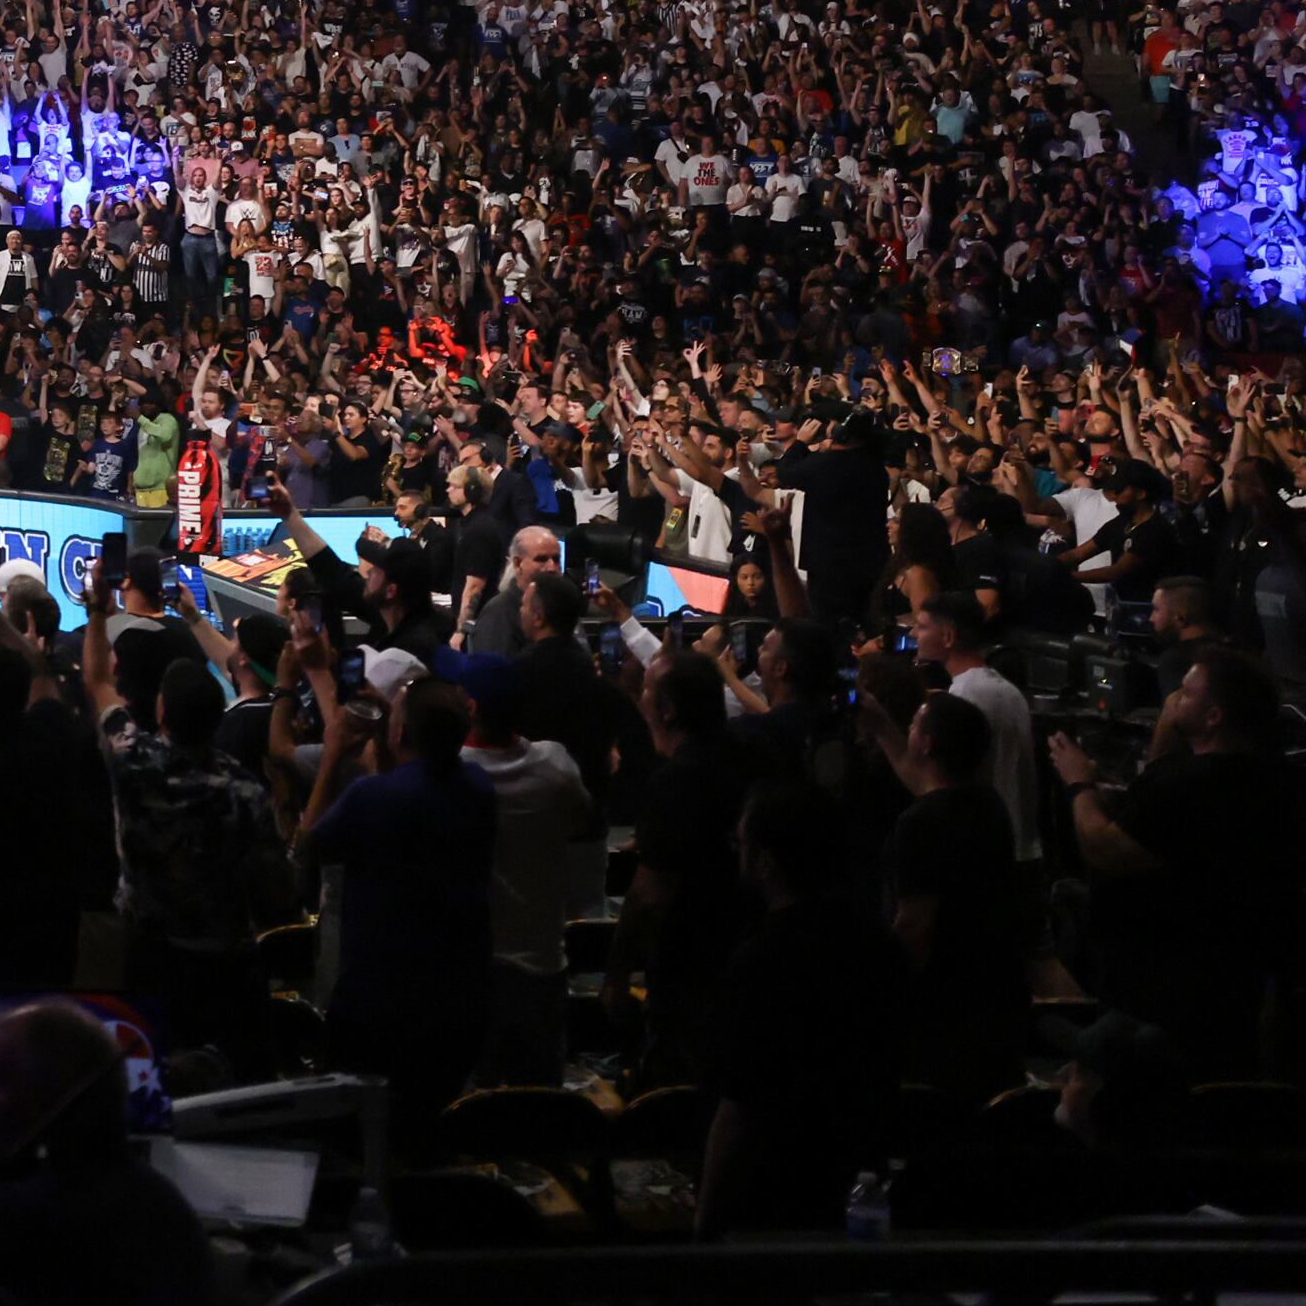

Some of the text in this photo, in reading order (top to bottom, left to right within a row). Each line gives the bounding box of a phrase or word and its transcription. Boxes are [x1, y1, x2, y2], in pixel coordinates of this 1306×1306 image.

[697, 169, 715, 177] THE
[693, 177, 720, 186] ONES
[178, 470, 202, 536] PRIME
